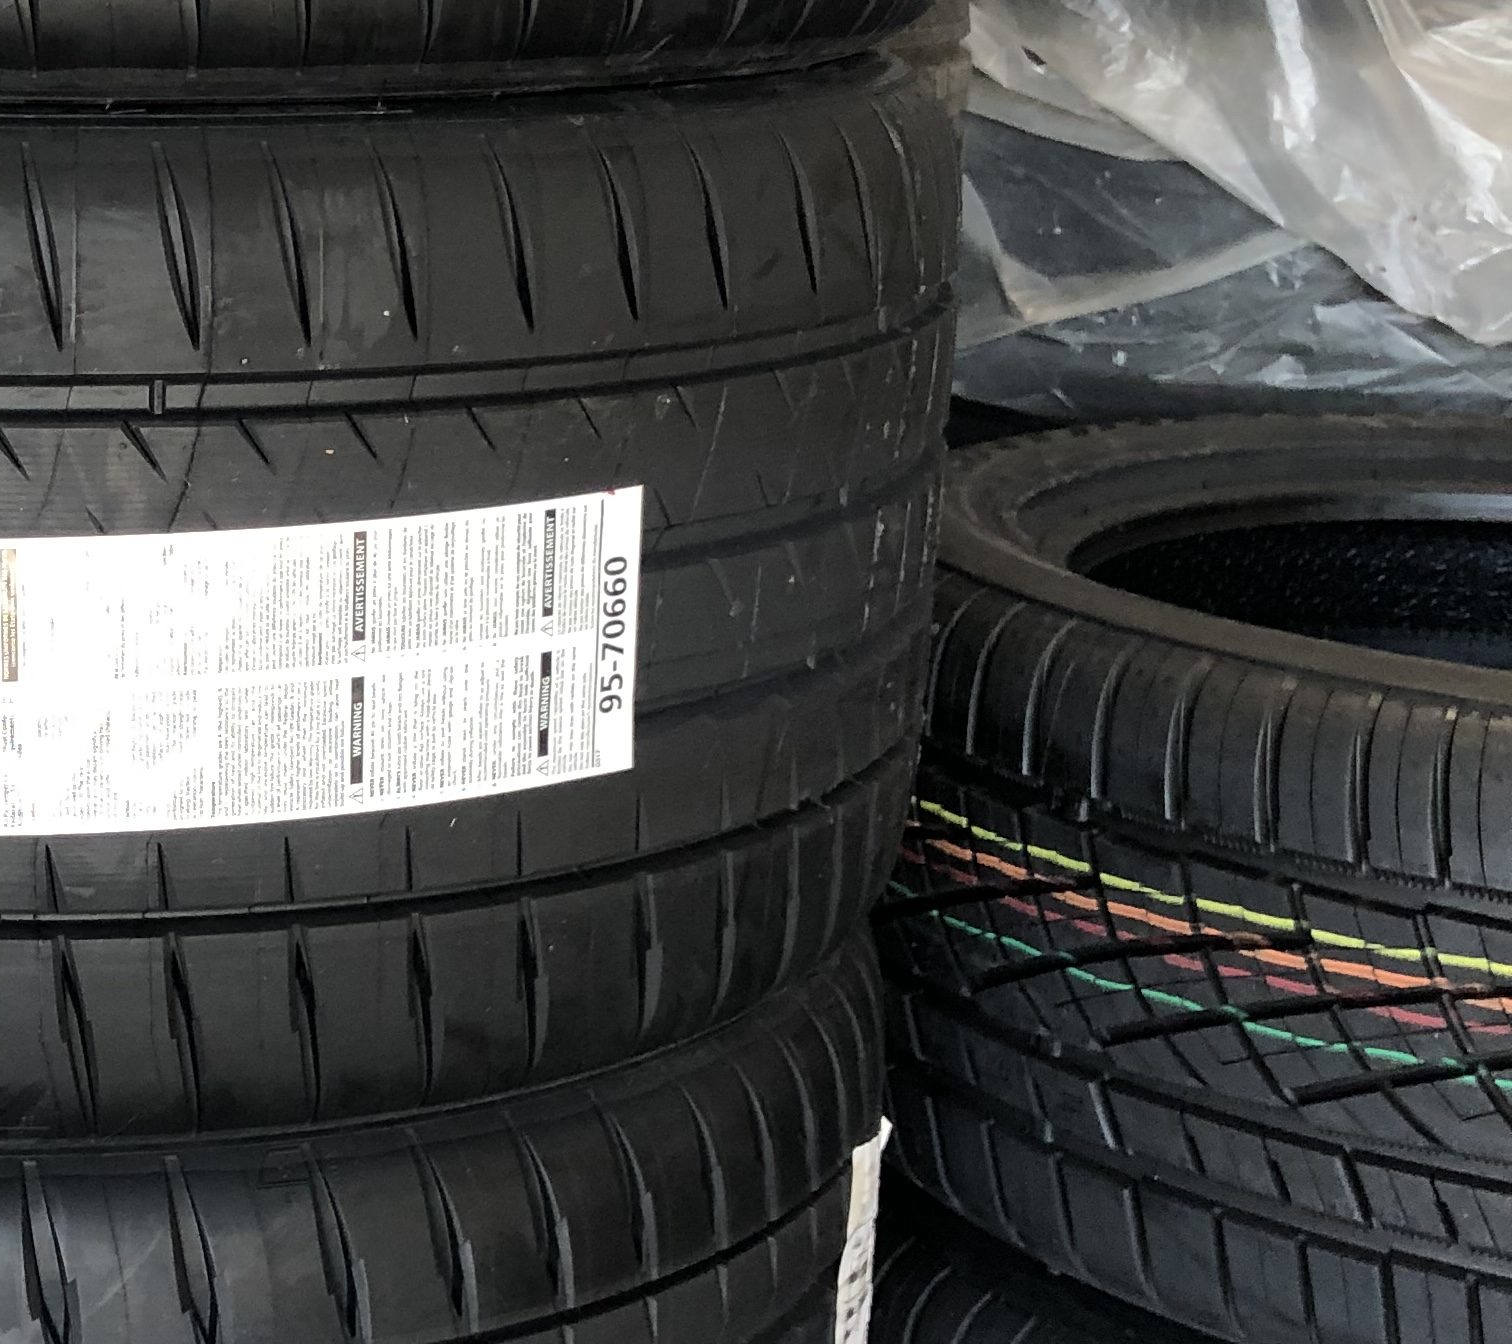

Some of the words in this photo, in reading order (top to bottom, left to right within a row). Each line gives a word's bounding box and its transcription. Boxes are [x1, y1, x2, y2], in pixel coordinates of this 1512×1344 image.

[354, 537, 366, 632] AVERTISSEMENT
[543, 515, 556, 609] AVERTISSEMENT
[599, 556, 628, 714] 95-70660
[351, 702, 364, 757] WARNING
[539, 675, 551, 731] WARNING
